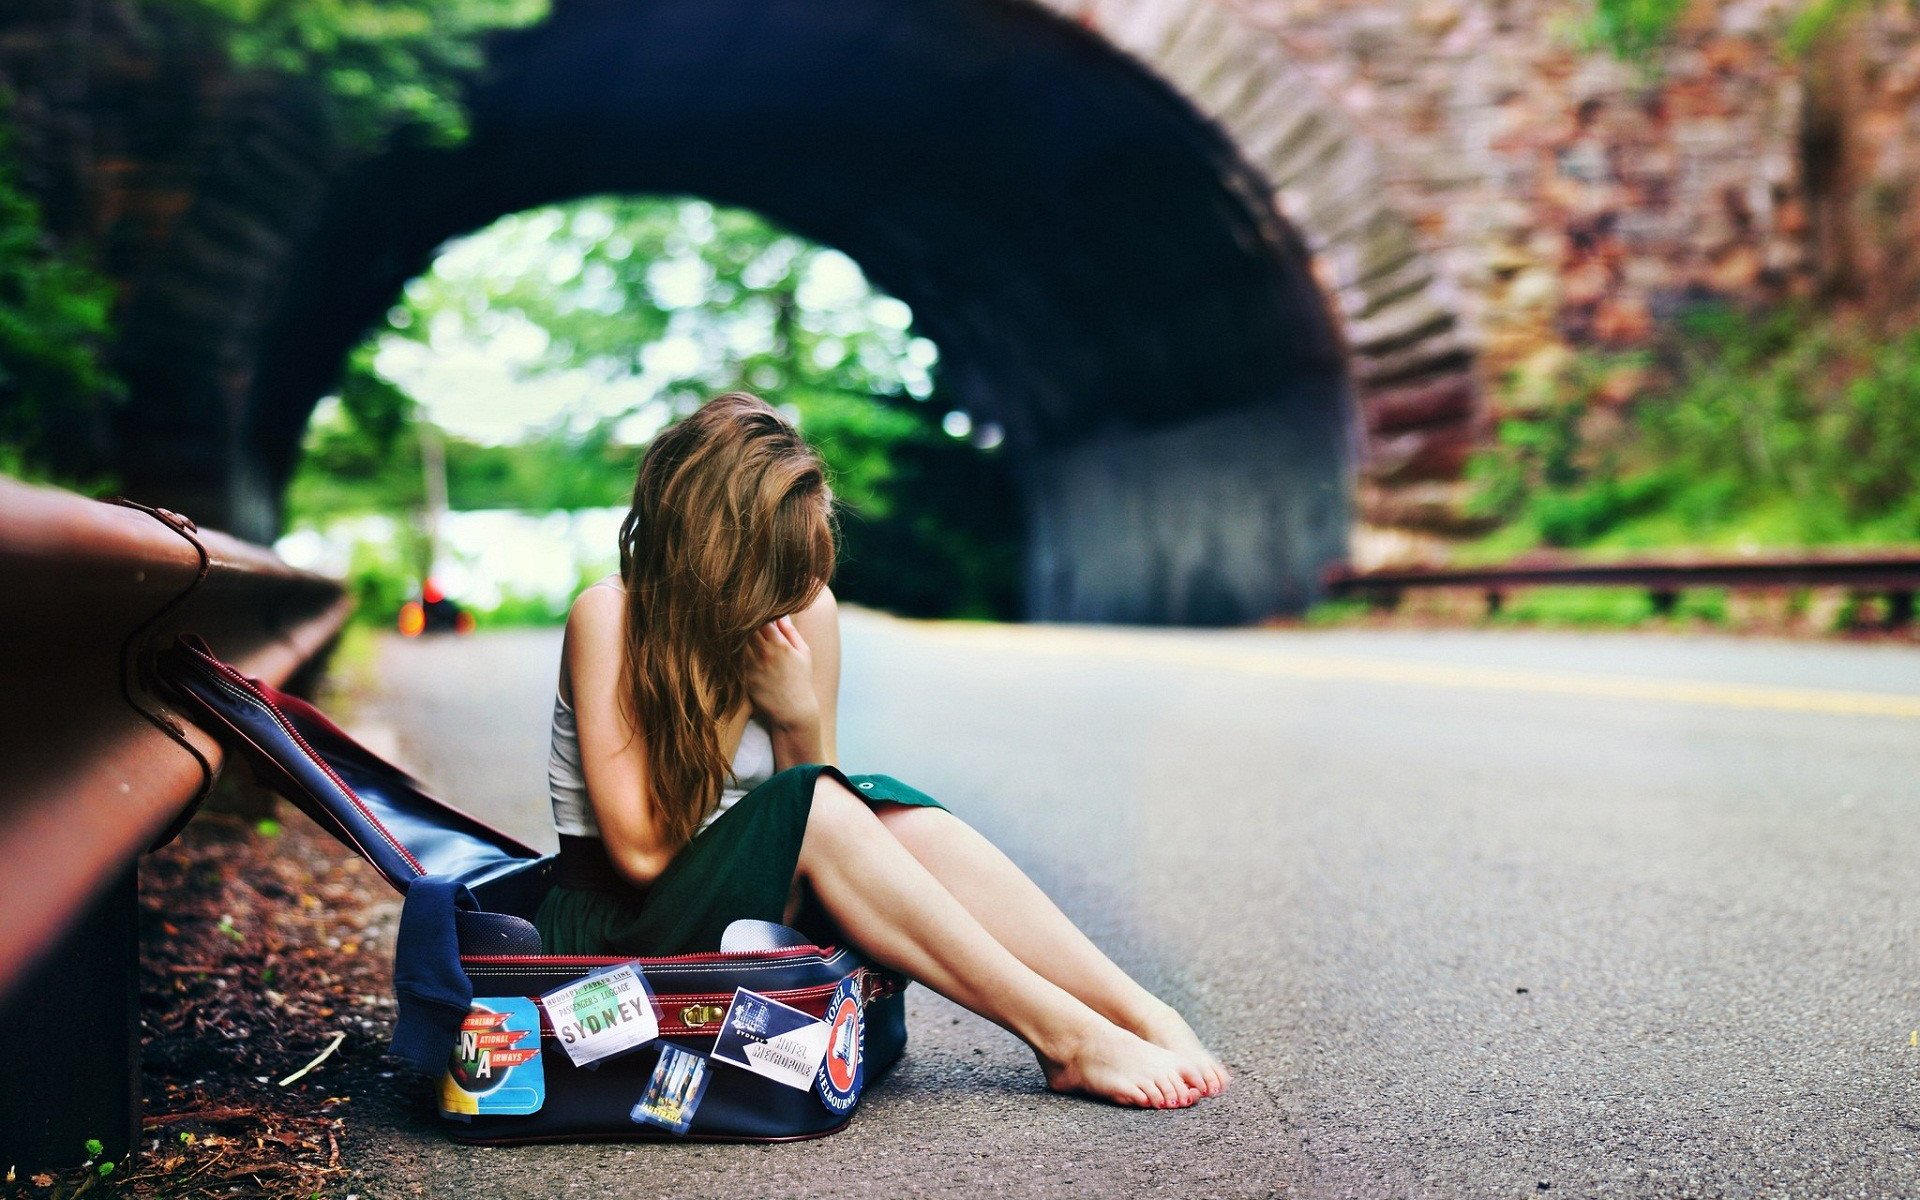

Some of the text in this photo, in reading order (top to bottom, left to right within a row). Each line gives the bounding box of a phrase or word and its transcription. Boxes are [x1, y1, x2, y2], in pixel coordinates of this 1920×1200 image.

[583, 977, 610, 992] PARKER
[613, 970, 631, 981] LINE
[601, 982, 630, 1000] LUGGAGE
[464, 1017, 496, 1026] STRALIAN
[561, 996, 643, 1044] SYDNEY
[736, 1030, 764, 1043] SYDNEY
[776, 1037, 807, 1059] HOTEL
[752, 1044, 813, 1077] METROPOLE
[819, 1066, 856, 1109] MELBOURNE
